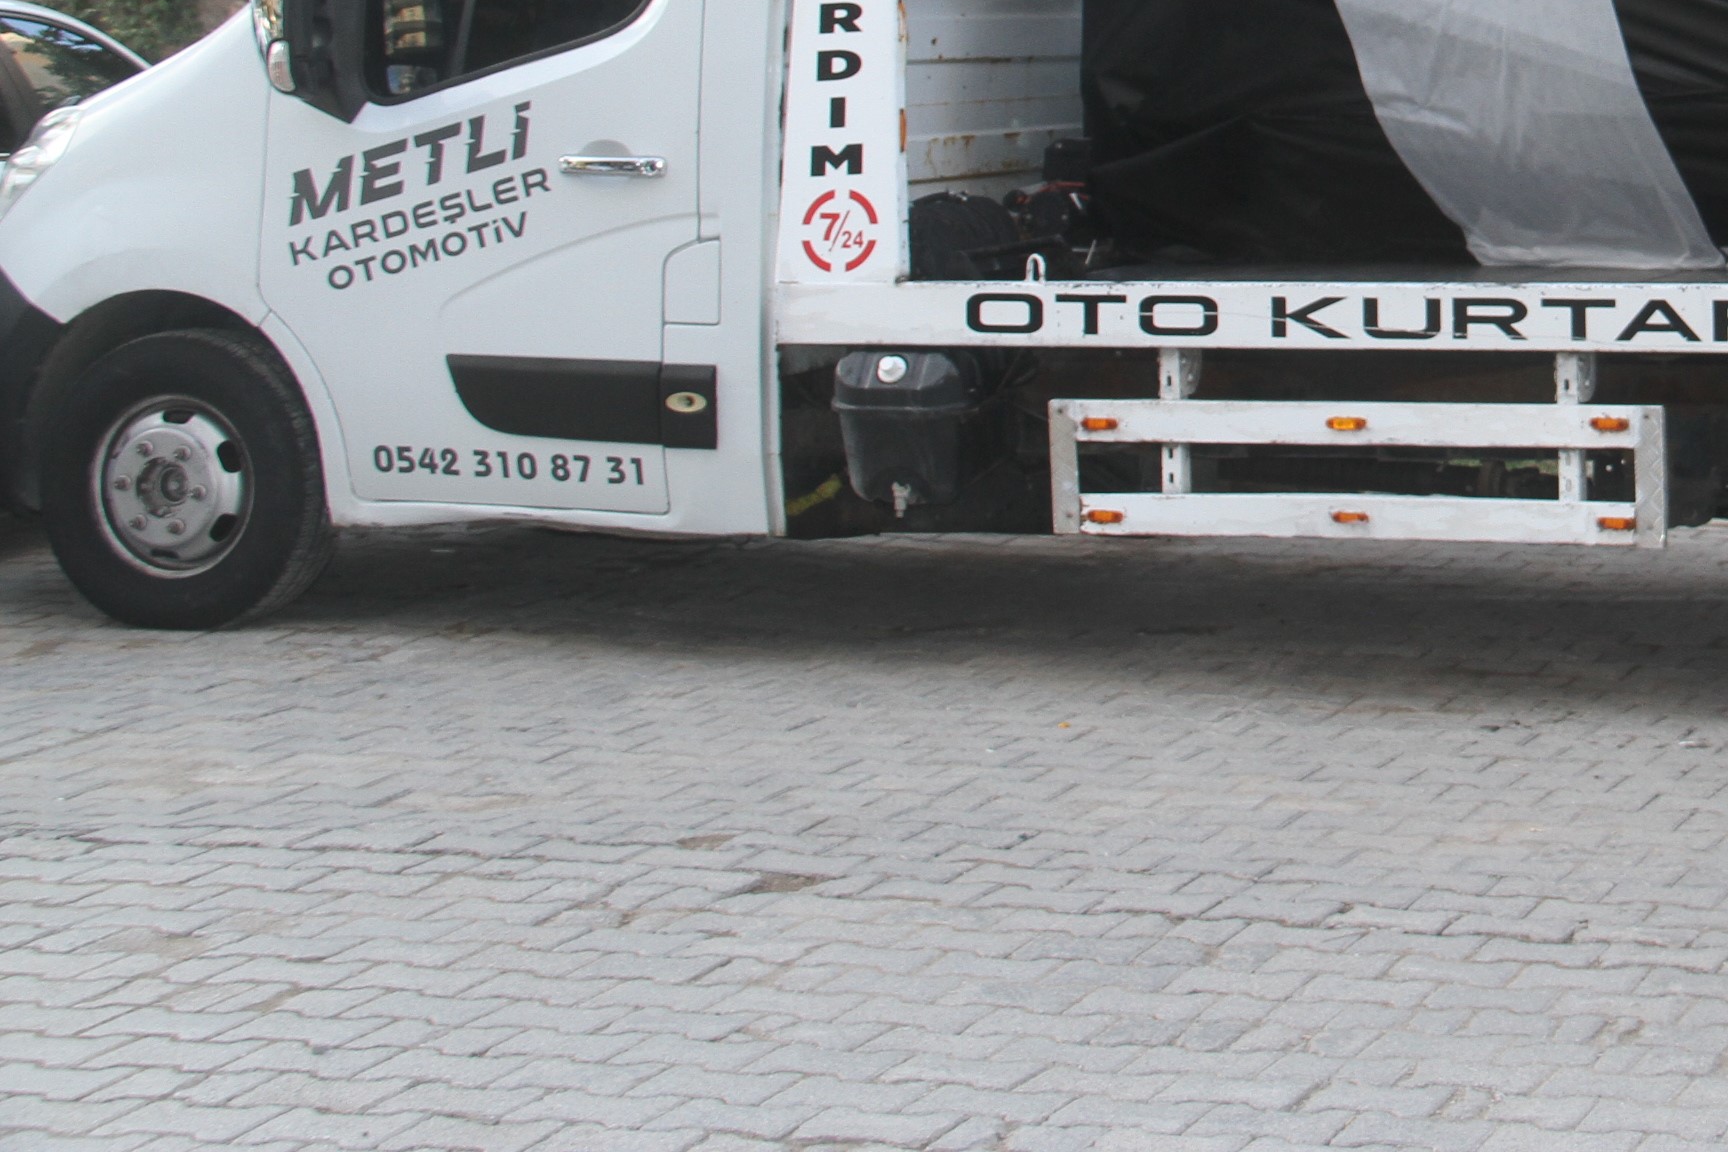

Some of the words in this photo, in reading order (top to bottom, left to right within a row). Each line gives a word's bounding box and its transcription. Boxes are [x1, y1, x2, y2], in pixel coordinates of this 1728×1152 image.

[965, 292, 1219, 337] OTO
[374, 445, 460, 476] 0542
[472, 449, 538, 480] 310
[551, 454, 591, 483] 87
[606, 456, 645, 486] 31
